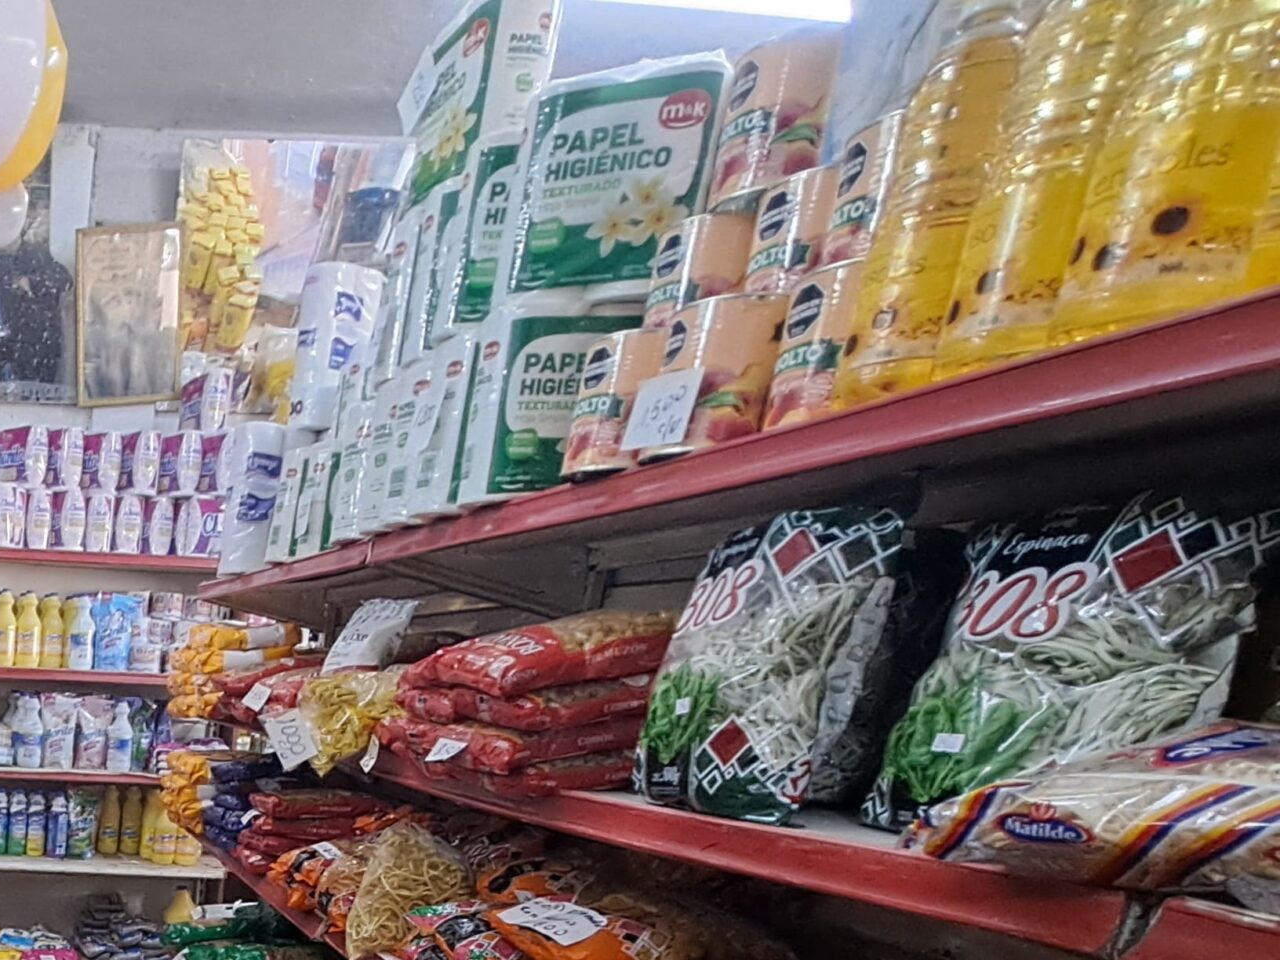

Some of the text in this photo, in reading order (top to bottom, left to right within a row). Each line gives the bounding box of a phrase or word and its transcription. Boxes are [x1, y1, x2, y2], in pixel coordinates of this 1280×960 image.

[552, 122, 645, 156] PAPEL
[544, 146, 673, 183] HIGIÉNICO
[543, 178, 621, 199] TEXTURADO
[1002, 533, 1091, 564] Espinaca
[1003, 817, 1079, 843] Matilde
